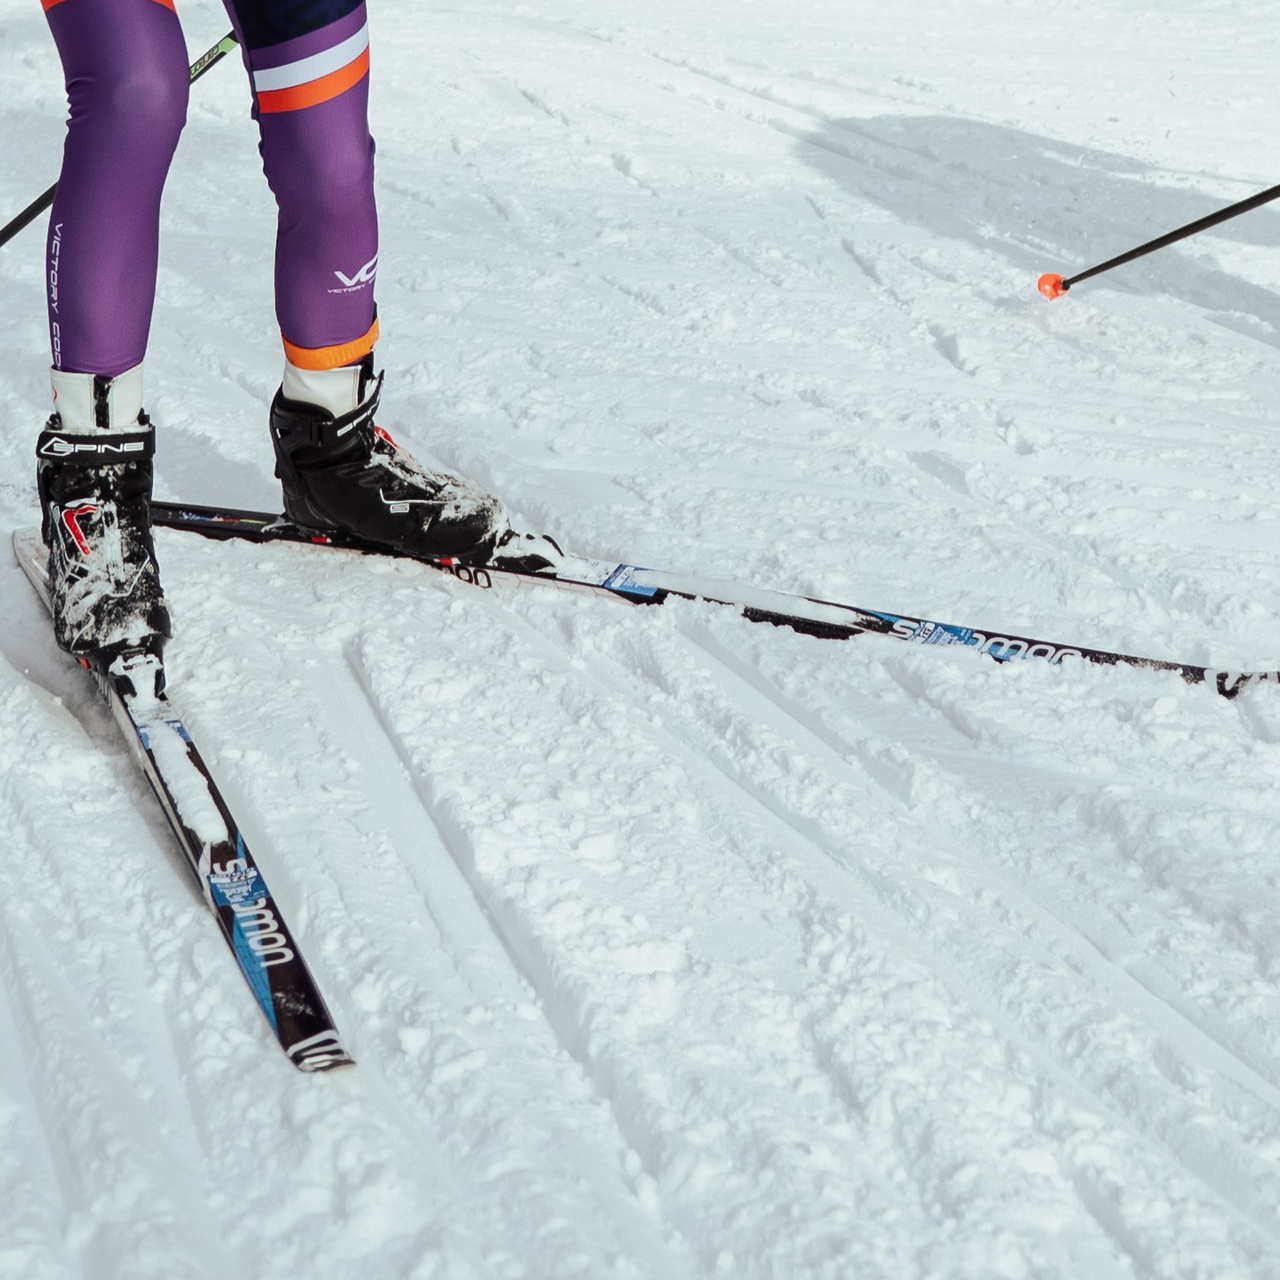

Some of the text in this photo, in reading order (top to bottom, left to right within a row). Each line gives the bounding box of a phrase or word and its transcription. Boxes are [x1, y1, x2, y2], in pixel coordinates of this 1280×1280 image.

[50, 223, 64, 370] VICTORY COD
[53, 441, 145, 454] SPINE
